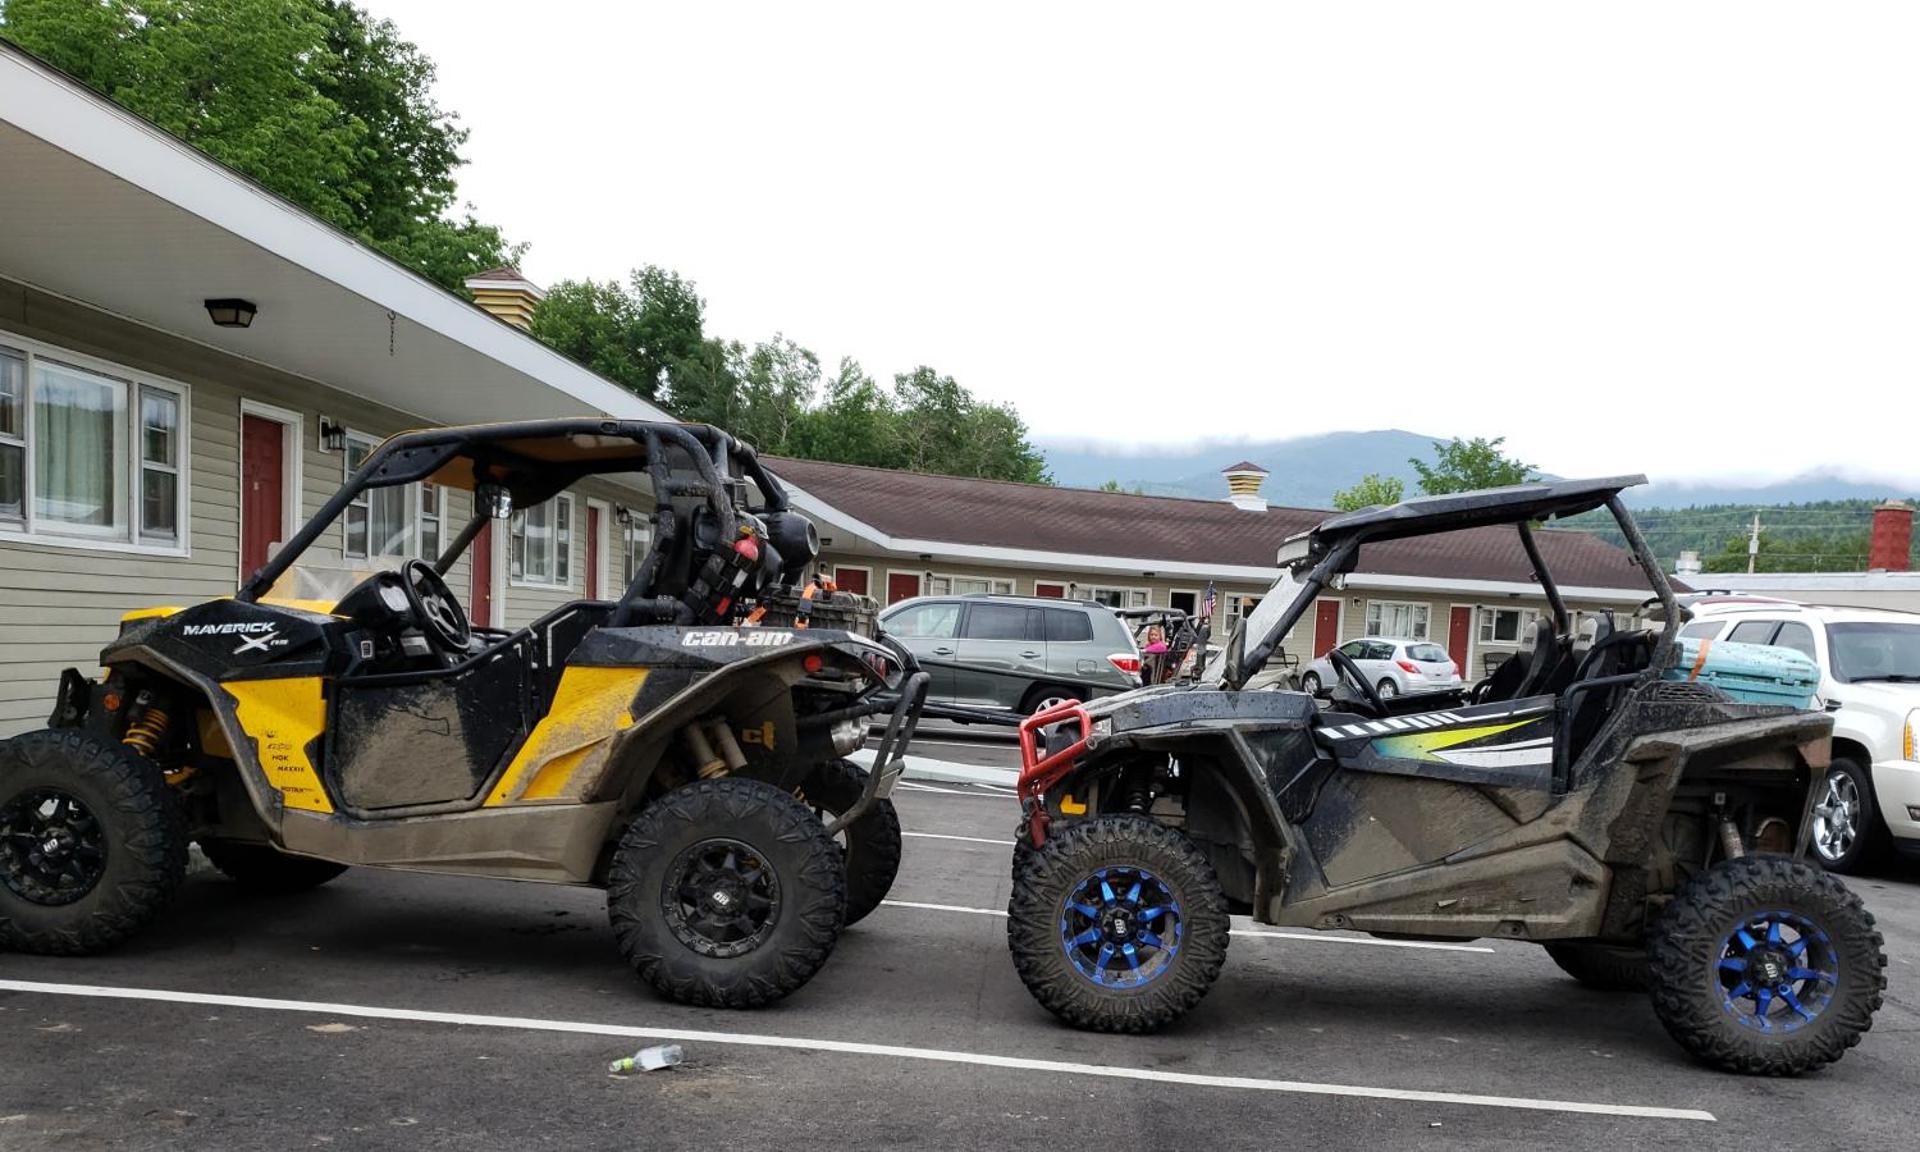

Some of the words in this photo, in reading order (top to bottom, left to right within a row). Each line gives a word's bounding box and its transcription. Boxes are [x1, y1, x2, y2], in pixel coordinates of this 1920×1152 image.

[183, 622, 276, 636] MAVERICK
[233, 631, 280, 654] X
[681, 631, 794, 646] can-am
